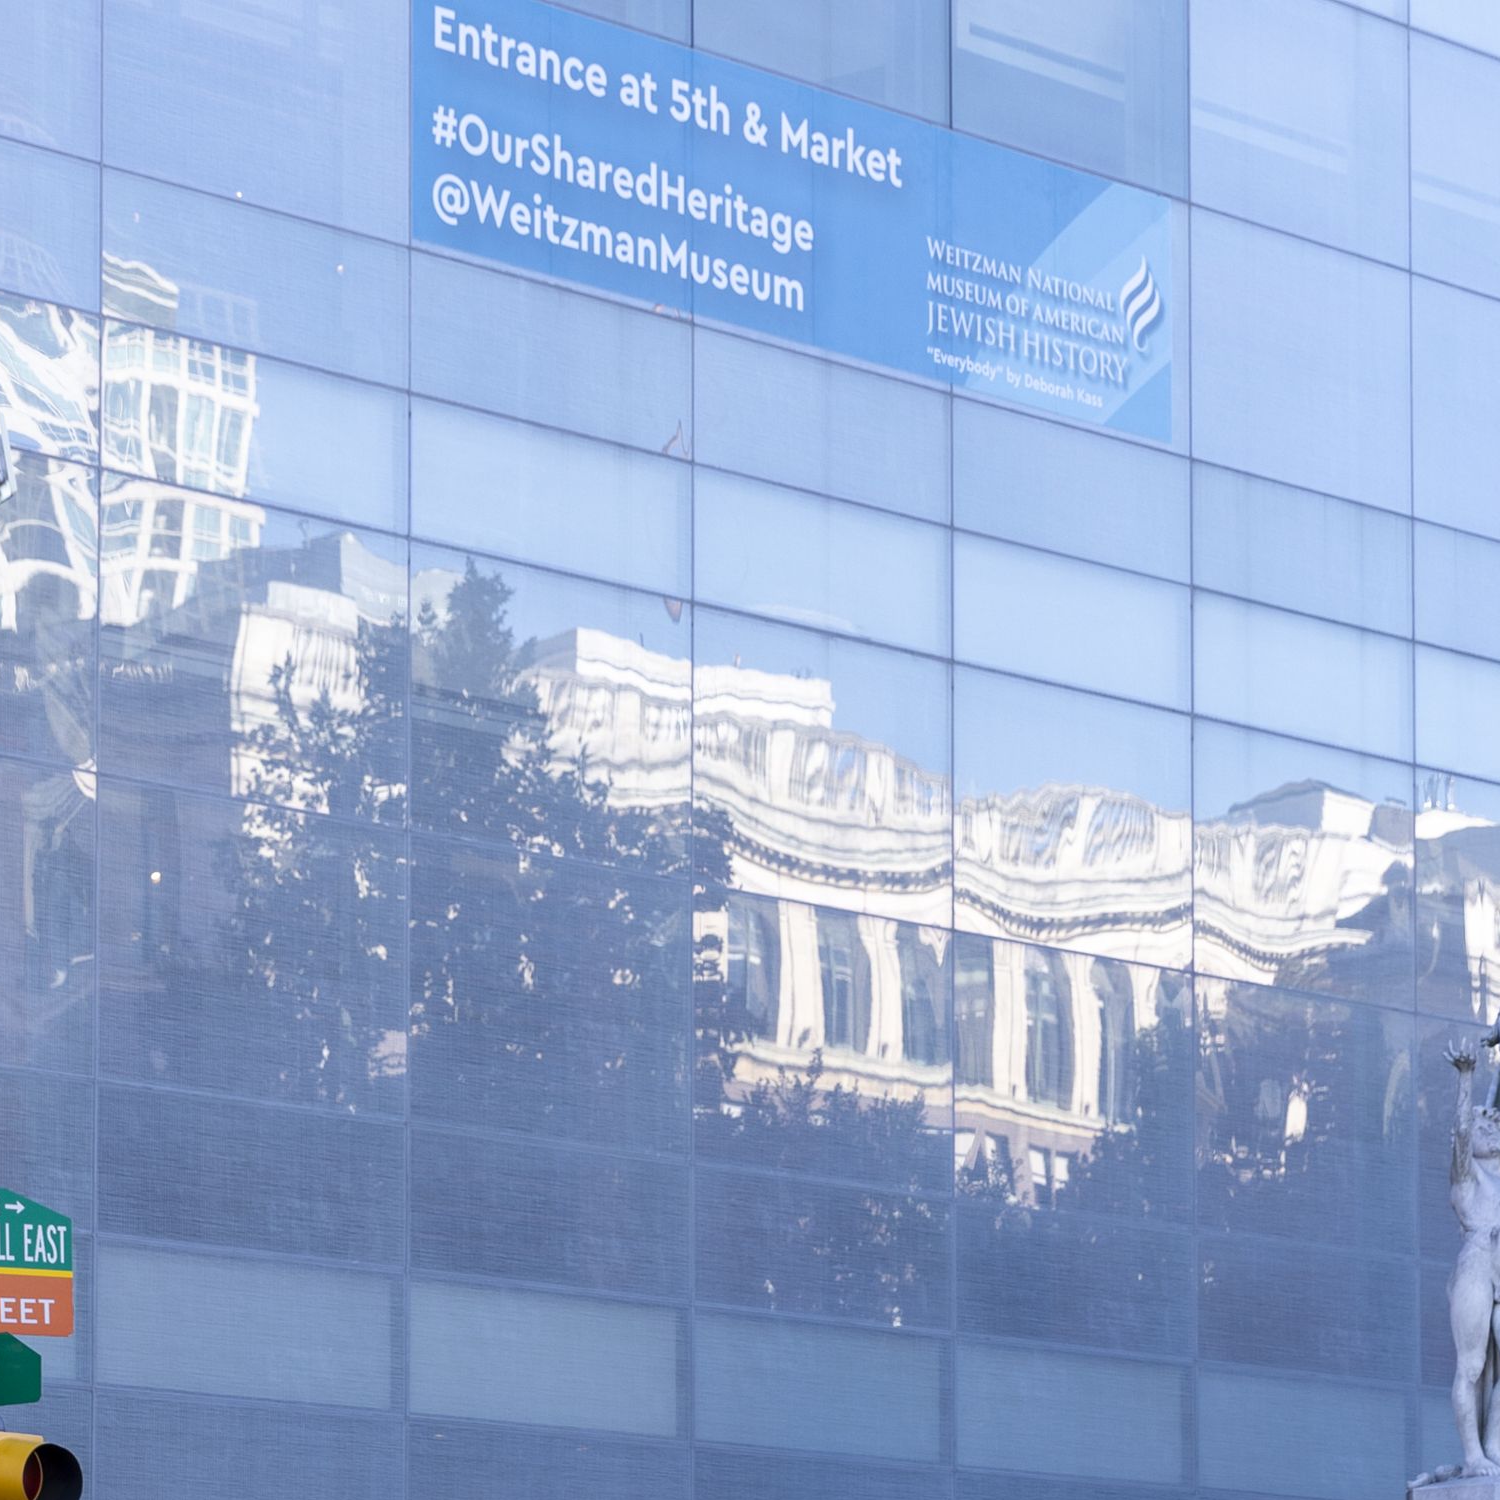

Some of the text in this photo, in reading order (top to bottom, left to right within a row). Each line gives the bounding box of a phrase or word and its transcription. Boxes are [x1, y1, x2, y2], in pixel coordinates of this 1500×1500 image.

[434, 5, 903, 189] Entrance at 5th & Market
[432, 104, 814, 254] #OurSharedHeritage
[432, 173, 804, 312] @WeitzmanMuseum
[926, 235, 1115, 312] WEITZMAN NATIONAL
[926, 271, 1125, 344] MUSEUM OF AMERICAN
[926, 301, 1128, 384] JEWISH HISTORY
[1006, 367, 1022, 388] by
[1025, 373, 1074, 401] Deborah
[1076, 387, 1103, 408] Kass
[23, 1224, 67, 1264] EAST
